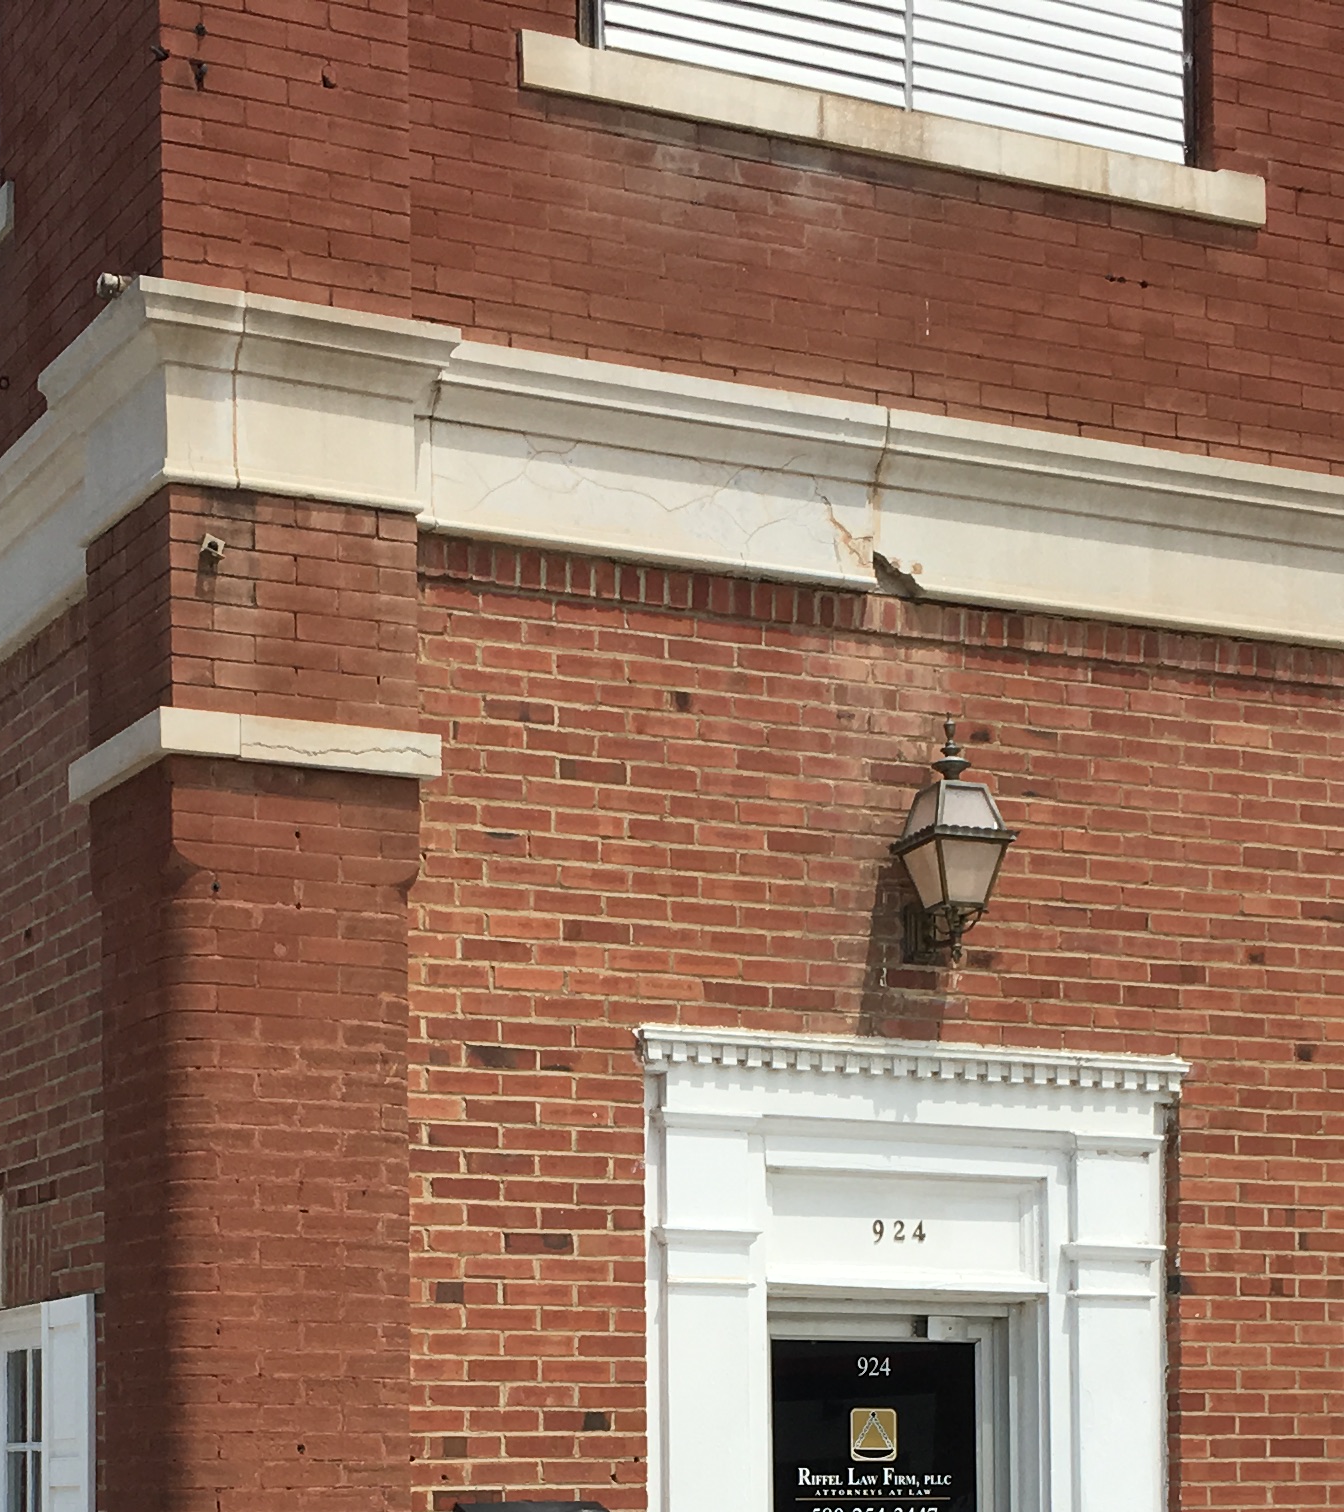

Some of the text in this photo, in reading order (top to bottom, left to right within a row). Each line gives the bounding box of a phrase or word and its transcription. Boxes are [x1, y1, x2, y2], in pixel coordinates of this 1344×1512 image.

[872, 1219, 926, 1244] 924
[857, 1356, 892, 1377] 924
[798, 1467, 952, 1487] RIFFEL LAW FIRM, PLLC
